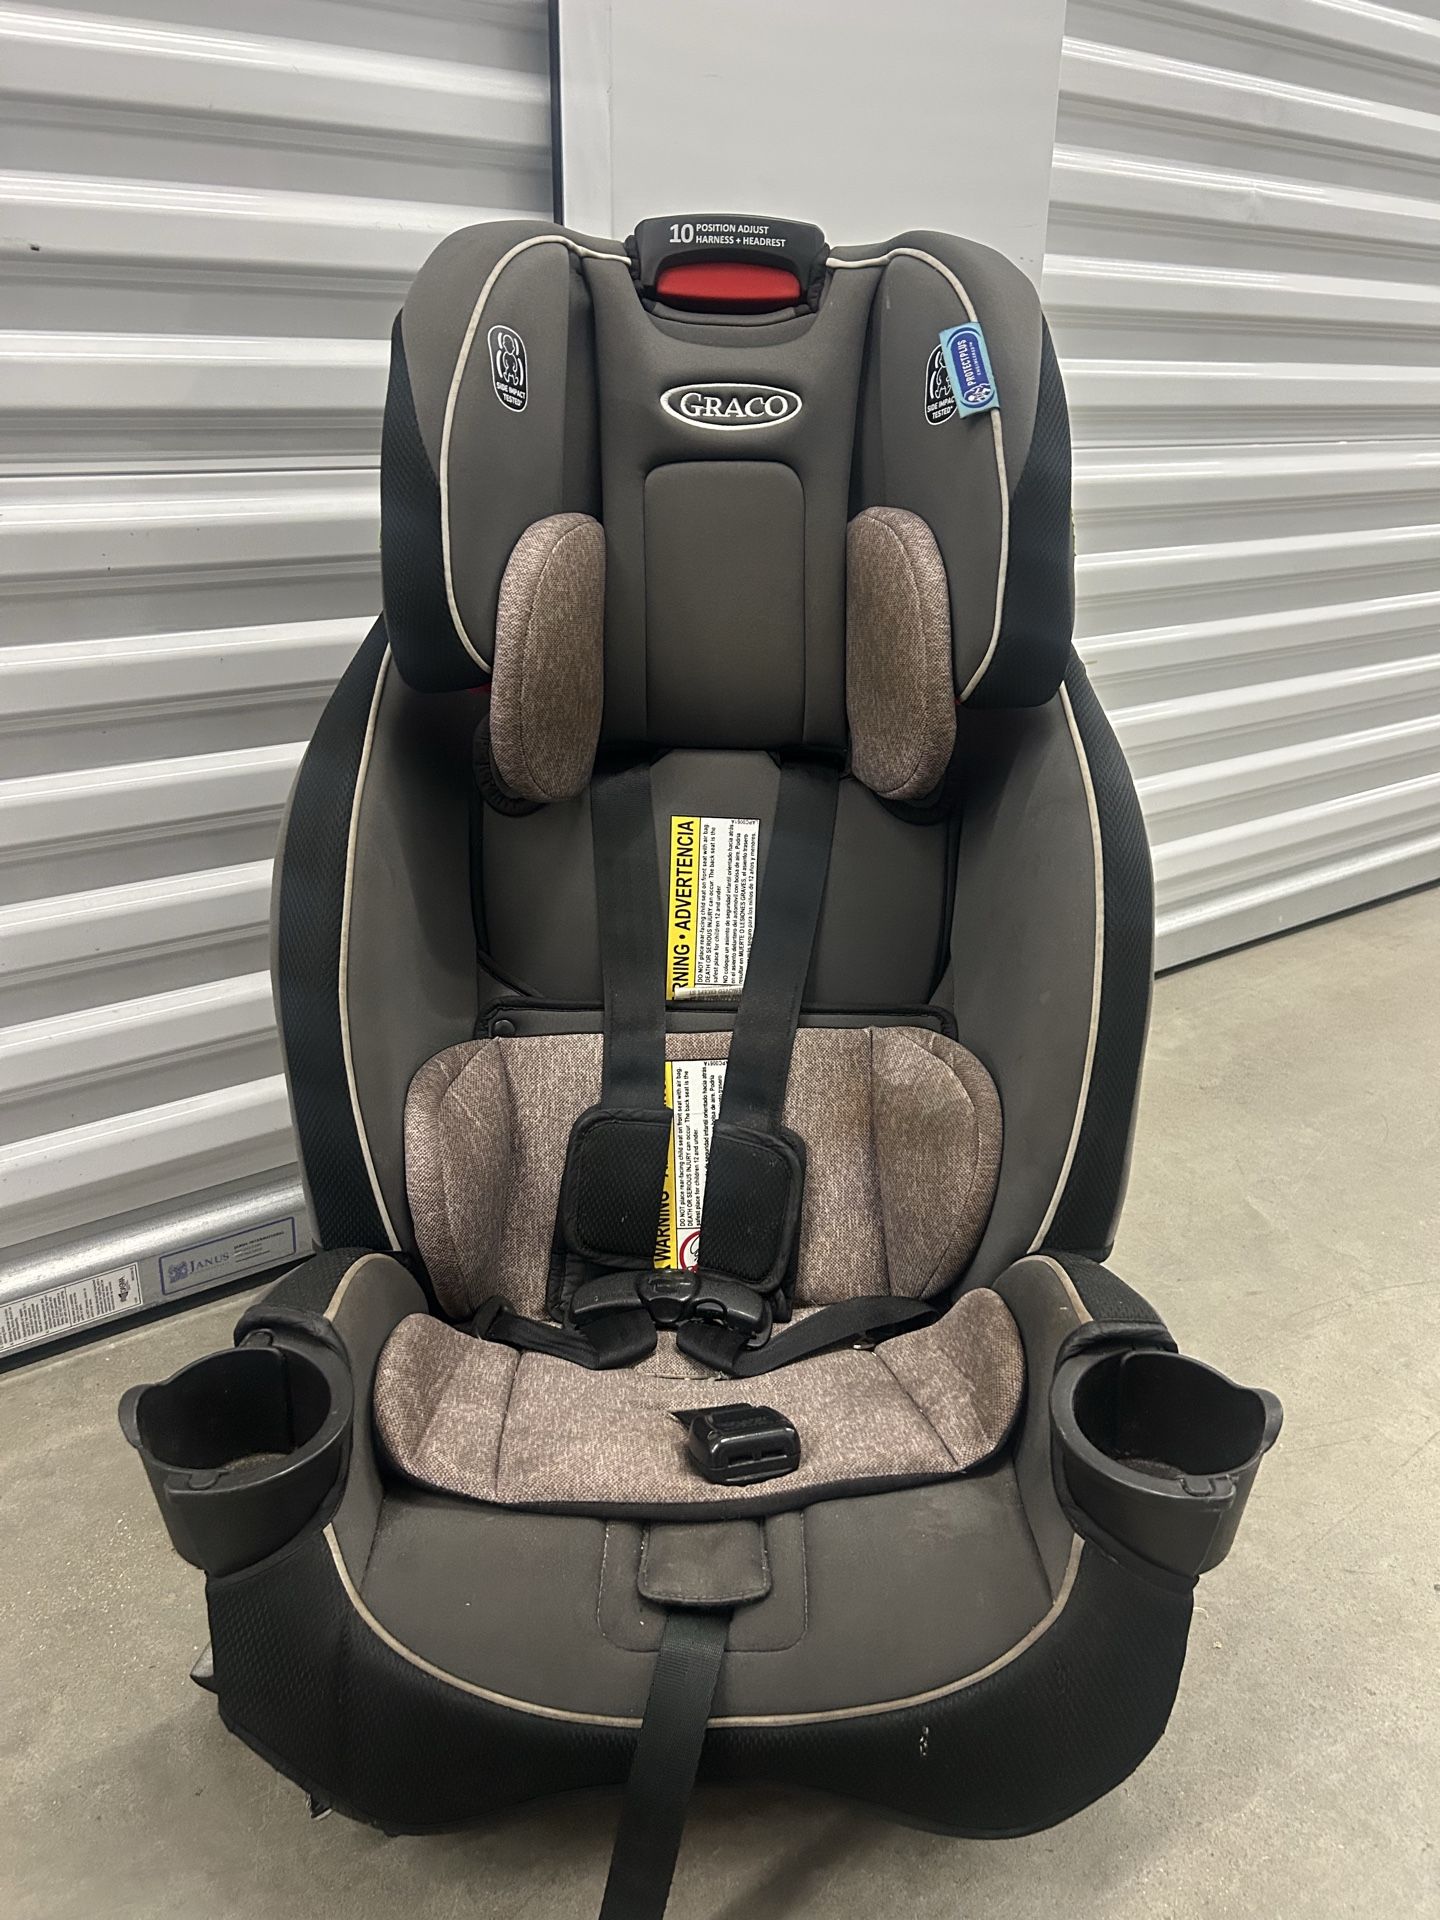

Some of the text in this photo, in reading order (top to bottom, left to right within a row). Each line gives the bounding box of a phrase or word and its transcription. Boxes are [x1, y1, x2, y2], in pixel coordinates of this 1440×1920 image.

[669, 223, 694, 243] 10
[696, 223, 769, 234] POSITION ADJUST
[695, 235, 734, 244] HARNESS
[742, 237, 786, 247] HEADREST
[957, 339, 977, 386] PROTECTPLUS
[680, 392, 788, 417] GRACO
[938, 396, 955, 408] IMPAC
[672, 820, 694, 993] RNING ADVERTENCIA
[706, 955, 711, 963] OR
[697, 974, 703, 983] DO
[723, 975, 728, 983] NO
[687, 1199, 692, 1207] OR
[190, 1252, 230, 1276] JANUS
